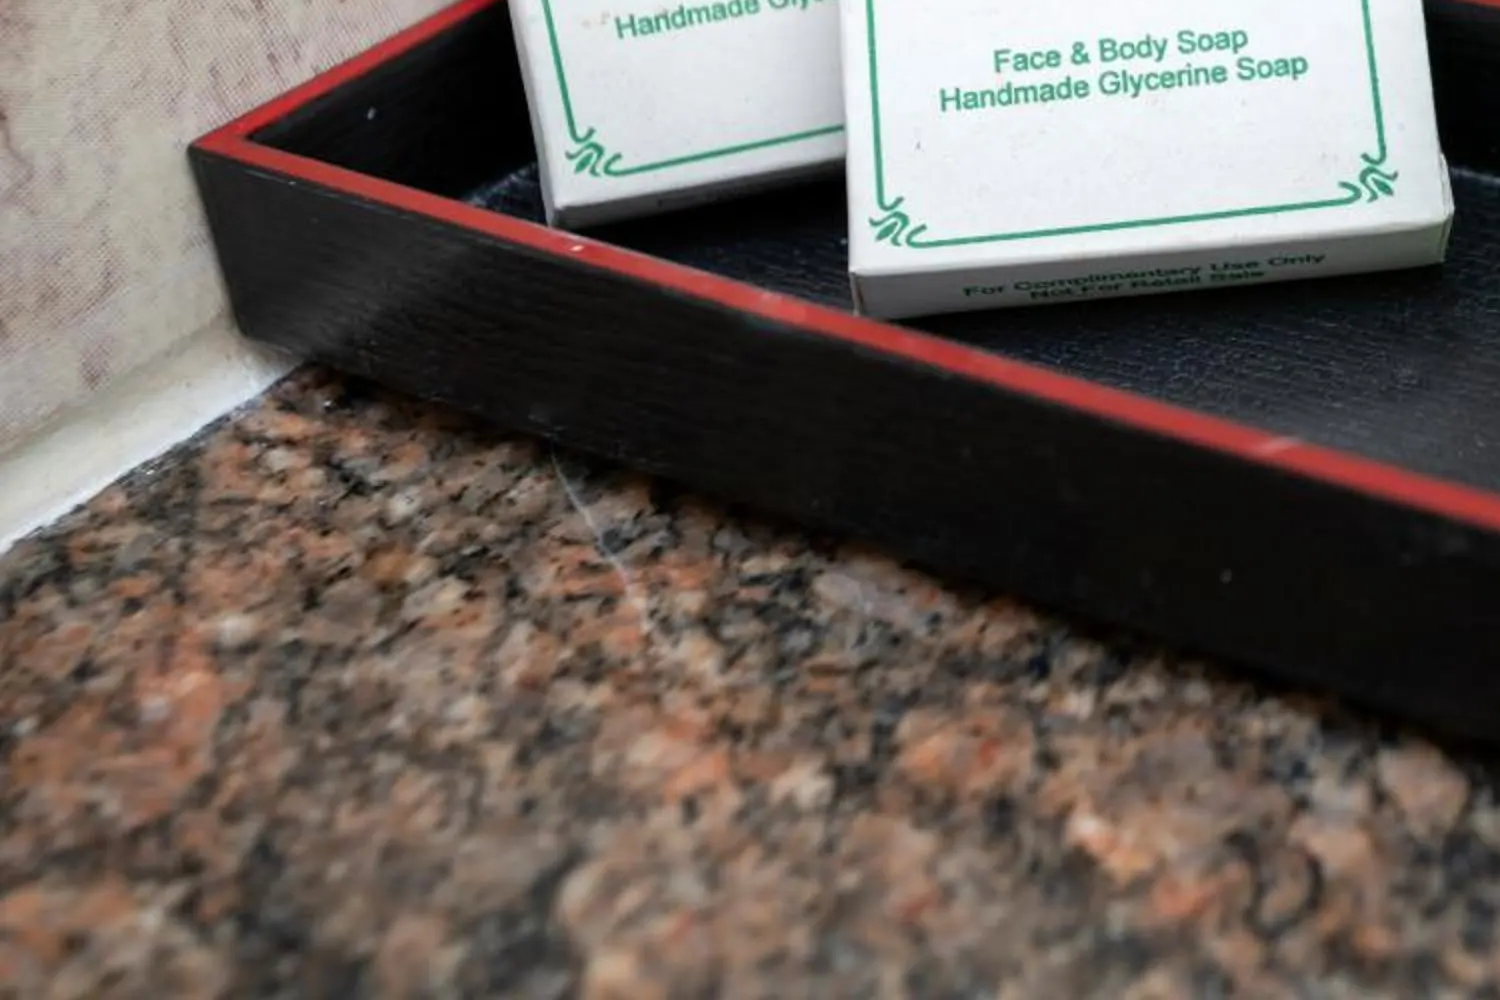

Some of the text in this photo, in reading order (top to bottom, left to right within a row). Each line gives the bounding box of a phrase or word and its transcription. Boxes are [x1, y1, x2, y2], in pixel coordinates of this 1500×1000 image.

[993, 28, 1249, 73] Face & Body Soap
[939, 53, 1309, 112] Handmade Glycerine Soap
[962, 253, 1327, 297] For Complimentary Use Only
[1029, 269, 1266, 299] Not For Retail Sale
